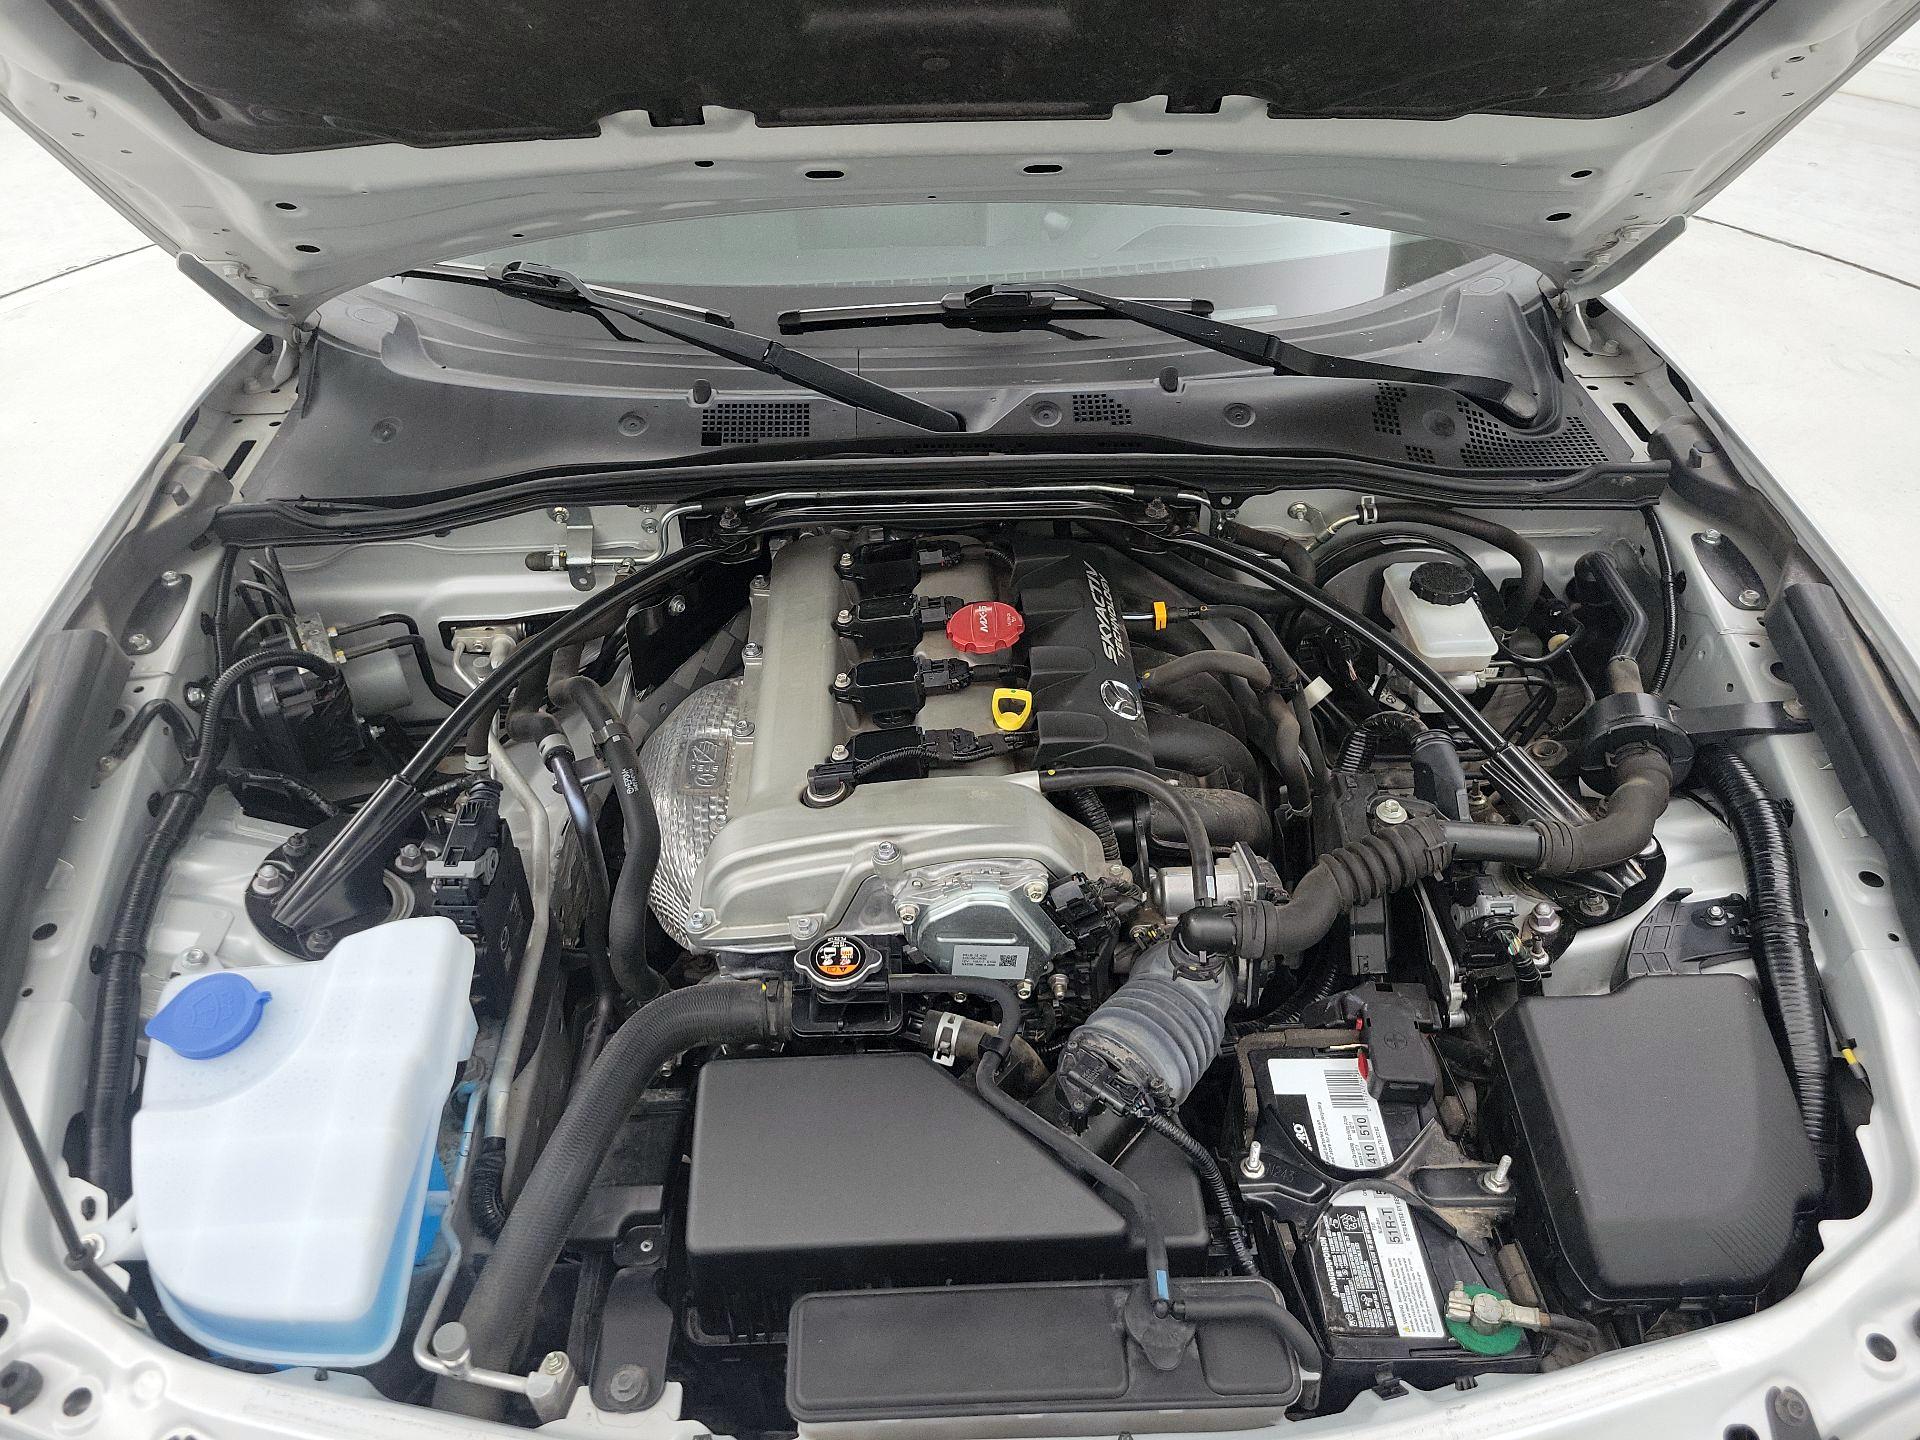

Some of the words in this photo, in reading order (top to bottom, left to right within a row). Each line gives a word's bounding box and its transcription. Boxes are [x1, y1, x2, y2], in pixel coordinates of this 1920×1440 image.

[1083, 560, 1118, 666] SKYACTIV
[1099, 573, 1126, 659] TECHNOLOGY
[1357, 1117, 1370, 1136] 510
[1364, 1145, 1377, 1164] 410
[1382, 1208, 1401, 1243] 51R-T
